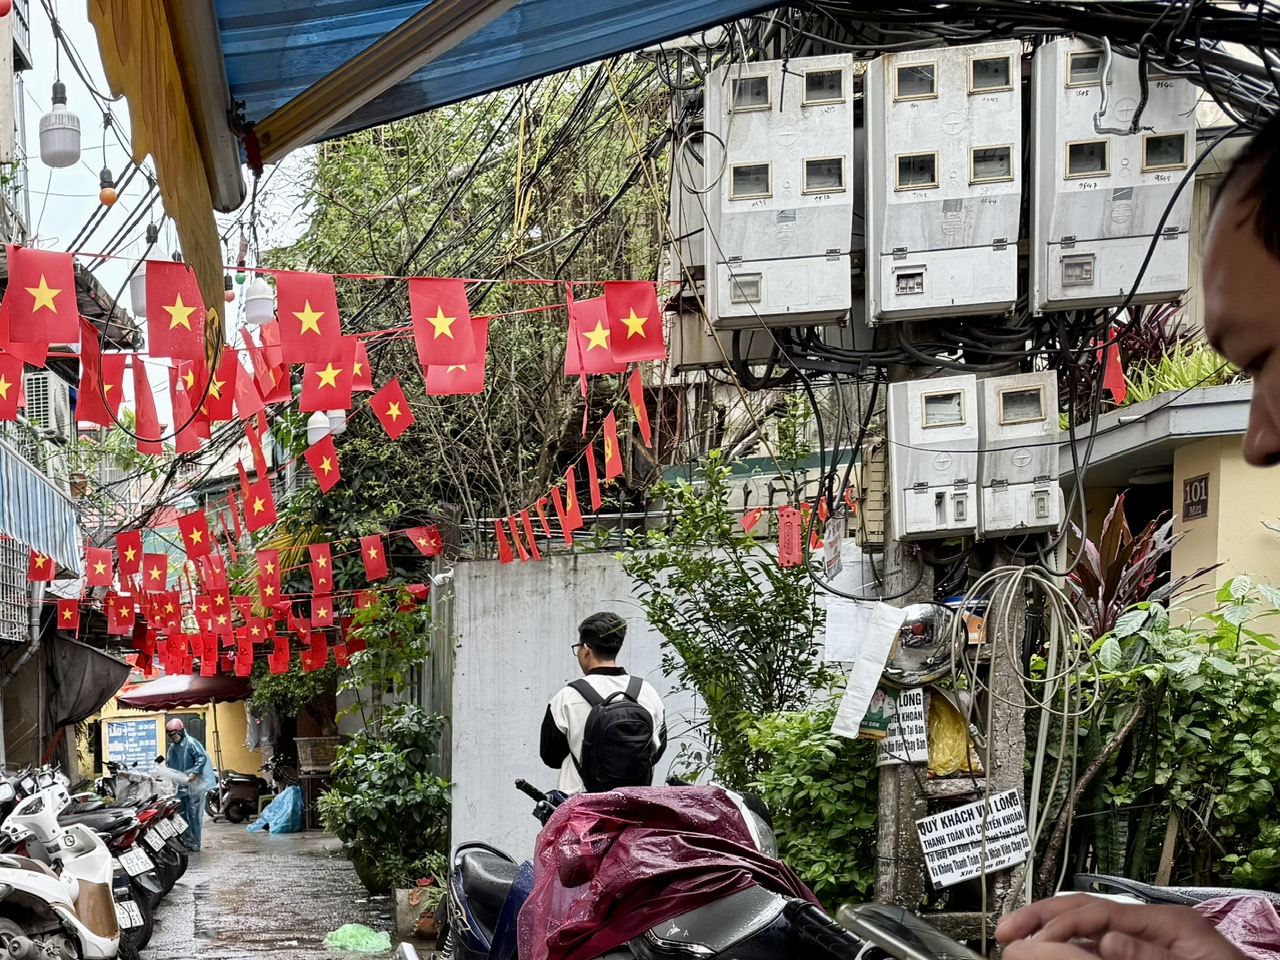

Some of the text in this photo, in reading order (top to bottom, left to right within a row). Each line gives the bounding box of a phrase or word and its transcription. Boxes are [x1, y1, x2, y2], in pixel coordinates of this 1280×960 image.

[1185, 479, 1207, 504] 101
[920, 816, 938, 837] QUÝ
[940, 807, 975, 830] KHÁCH
[923, 835, 946, 850] THANH
[946, 828, 965, 843] TOÁN
[965, 824, 976, 838] VÀ
[1002, 807, 1024, 826] KHOẢN
